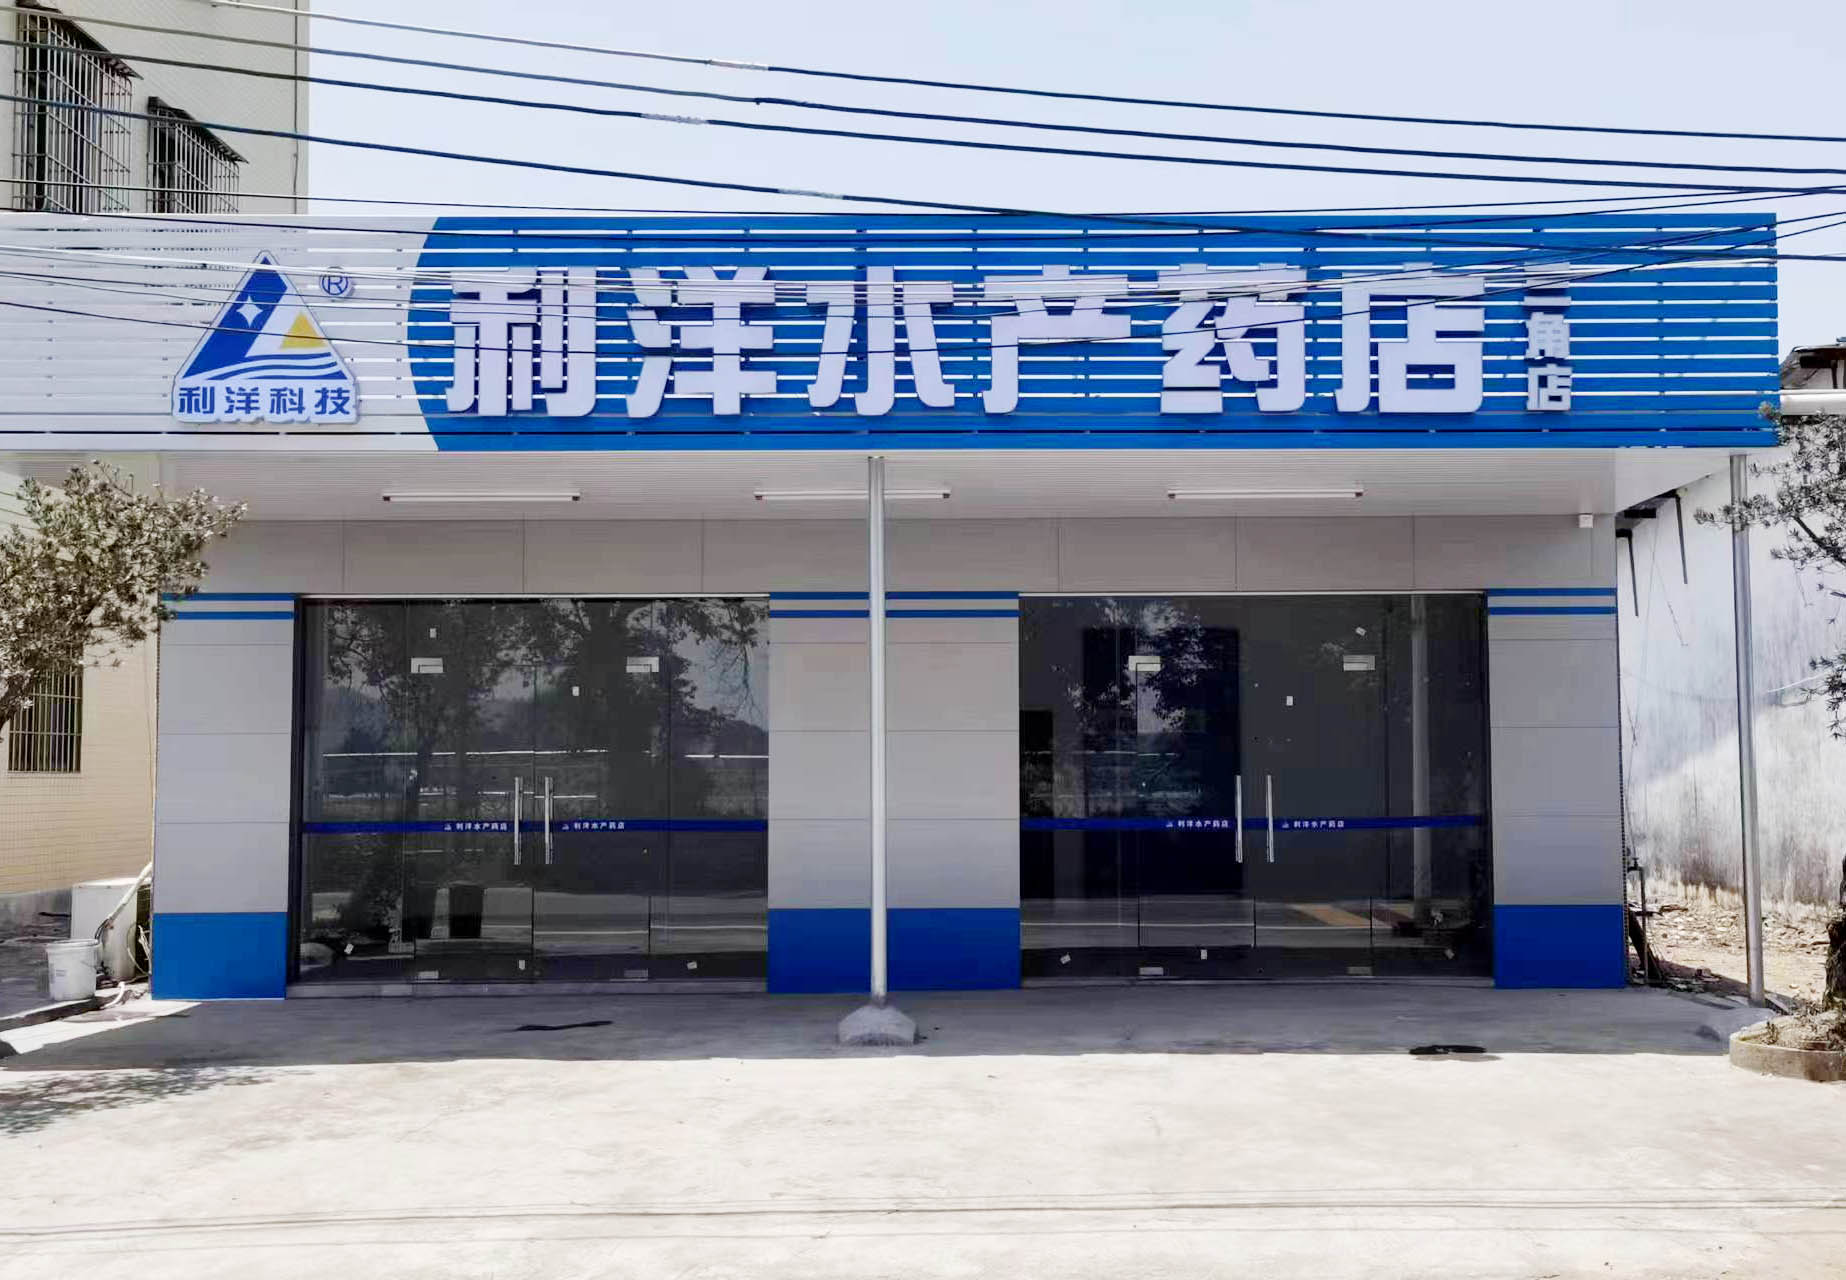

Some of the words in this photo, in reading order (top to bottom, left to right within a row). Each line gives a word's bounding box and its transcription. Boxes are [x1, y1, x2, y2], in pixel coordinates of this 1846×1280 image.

[446, 263, 1485, 417] 利洋水产药店
[178, 386, 350, 415] 利洋科技
